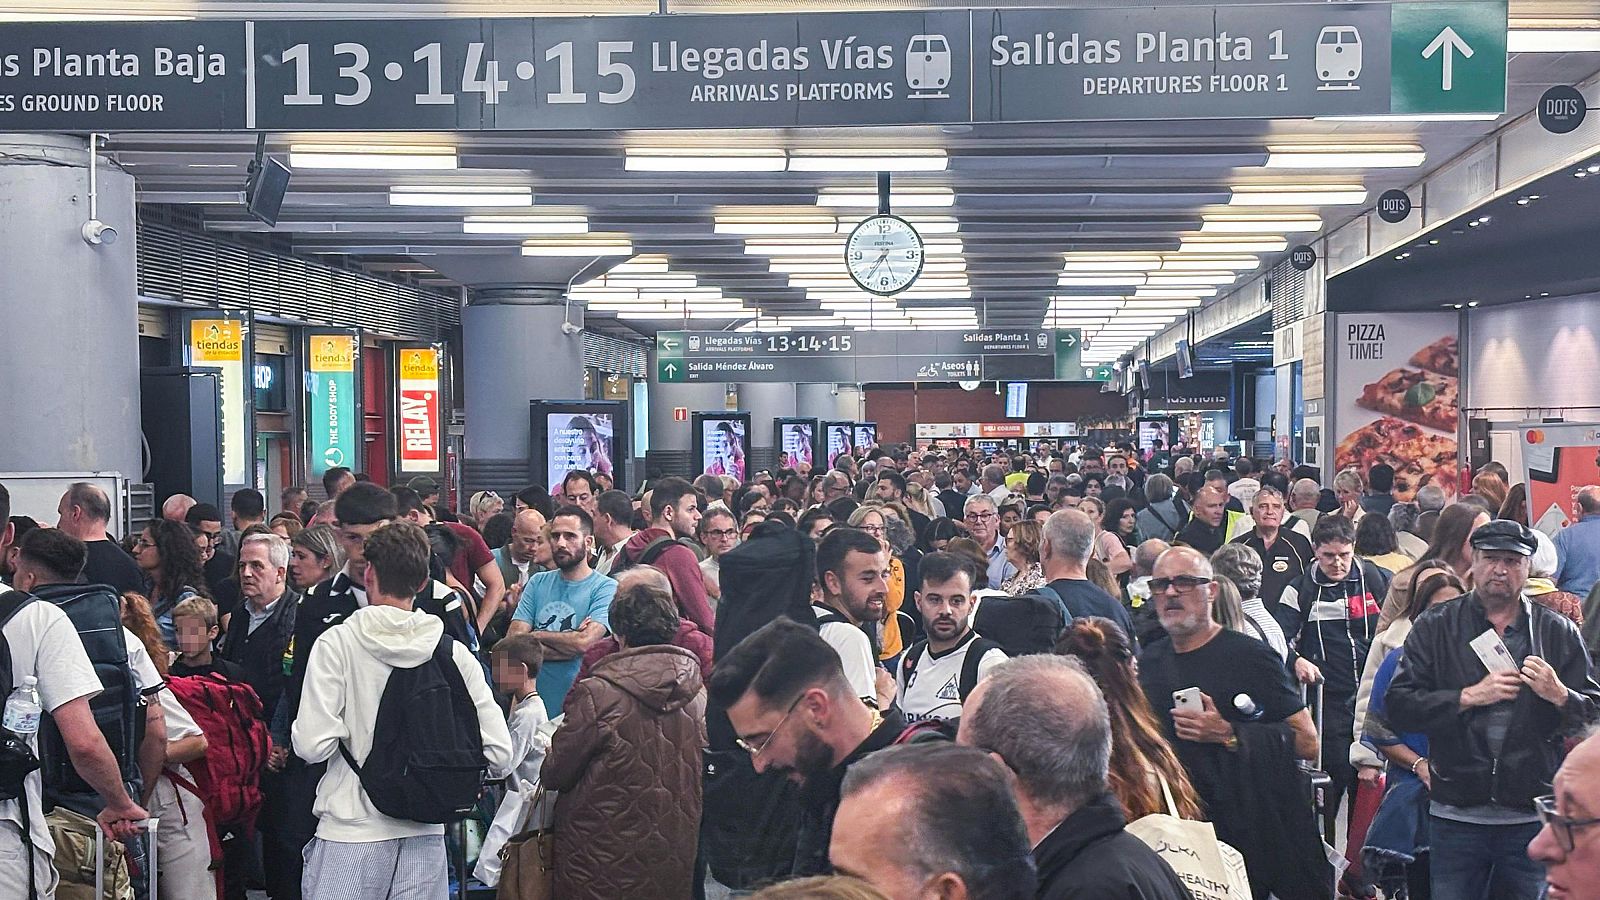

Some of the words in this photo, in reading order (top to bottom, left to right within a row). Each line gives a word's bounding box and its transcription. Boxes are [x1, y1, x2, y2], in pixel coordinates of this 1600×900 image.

[991, 31, 1121, 66] Salidas
[1136, 27, 1253, 64] Planta
[1267, 29, 1289, 61] 1
[0, 54, 20, 76] s
[33, 47, 139, 76] Planta
[154, 44, 226, 83] Baja
[651, 39, 809, 83] Llegadas
[820, 35, 893, 70] Vías
[690, 83, 779, 103] ARRIVALS
[786, 81, 893, 101] PLATFORMS
[1083, 74, 1202, 95] DEPARTURES
[1209, 74, 1269, 93] FLOOR
[1276, 74, 1288, 92] 1
[21, 94, 100, 112] GROUND
[107, 94, 164, 112] FLOOR
[1546, 98, 1578, 115] DOTS
[1383, 198, 1405, 211] DOTS
[878, 224, 891, 234] 12
[854, 250, 862, 260] 9
[906, 250, 914, 260] 3
[880, 276, 888, 286] 6
[963, 334, 992, 342] Salidas
[996, 334, 1022, 342] Planta
[1024, 333, 1030, 341] 1
[1348, 324, 1386, 341] PIZZA
[196, 340, 238, 350] tiendas
[705, 336, 743, 347] Llegadas
[744, 336, 762, 345] Vías
[1348, 343, 1382, 360] TIME!
[404, 364, 434, 372] tiendas
[688, 362, 713, 371] Salida
[716, 362, 747, 371] Méndez
[748, 361, 774, 371] Álvaro
[942, 362, 966, 370] Aseos
[328, 380, 337, 402] SHOP
[330, 403, 338, 424] BODY
[330, 427, 338, 445] THE
[1177, 872, 1230, 895] HEALTHY
